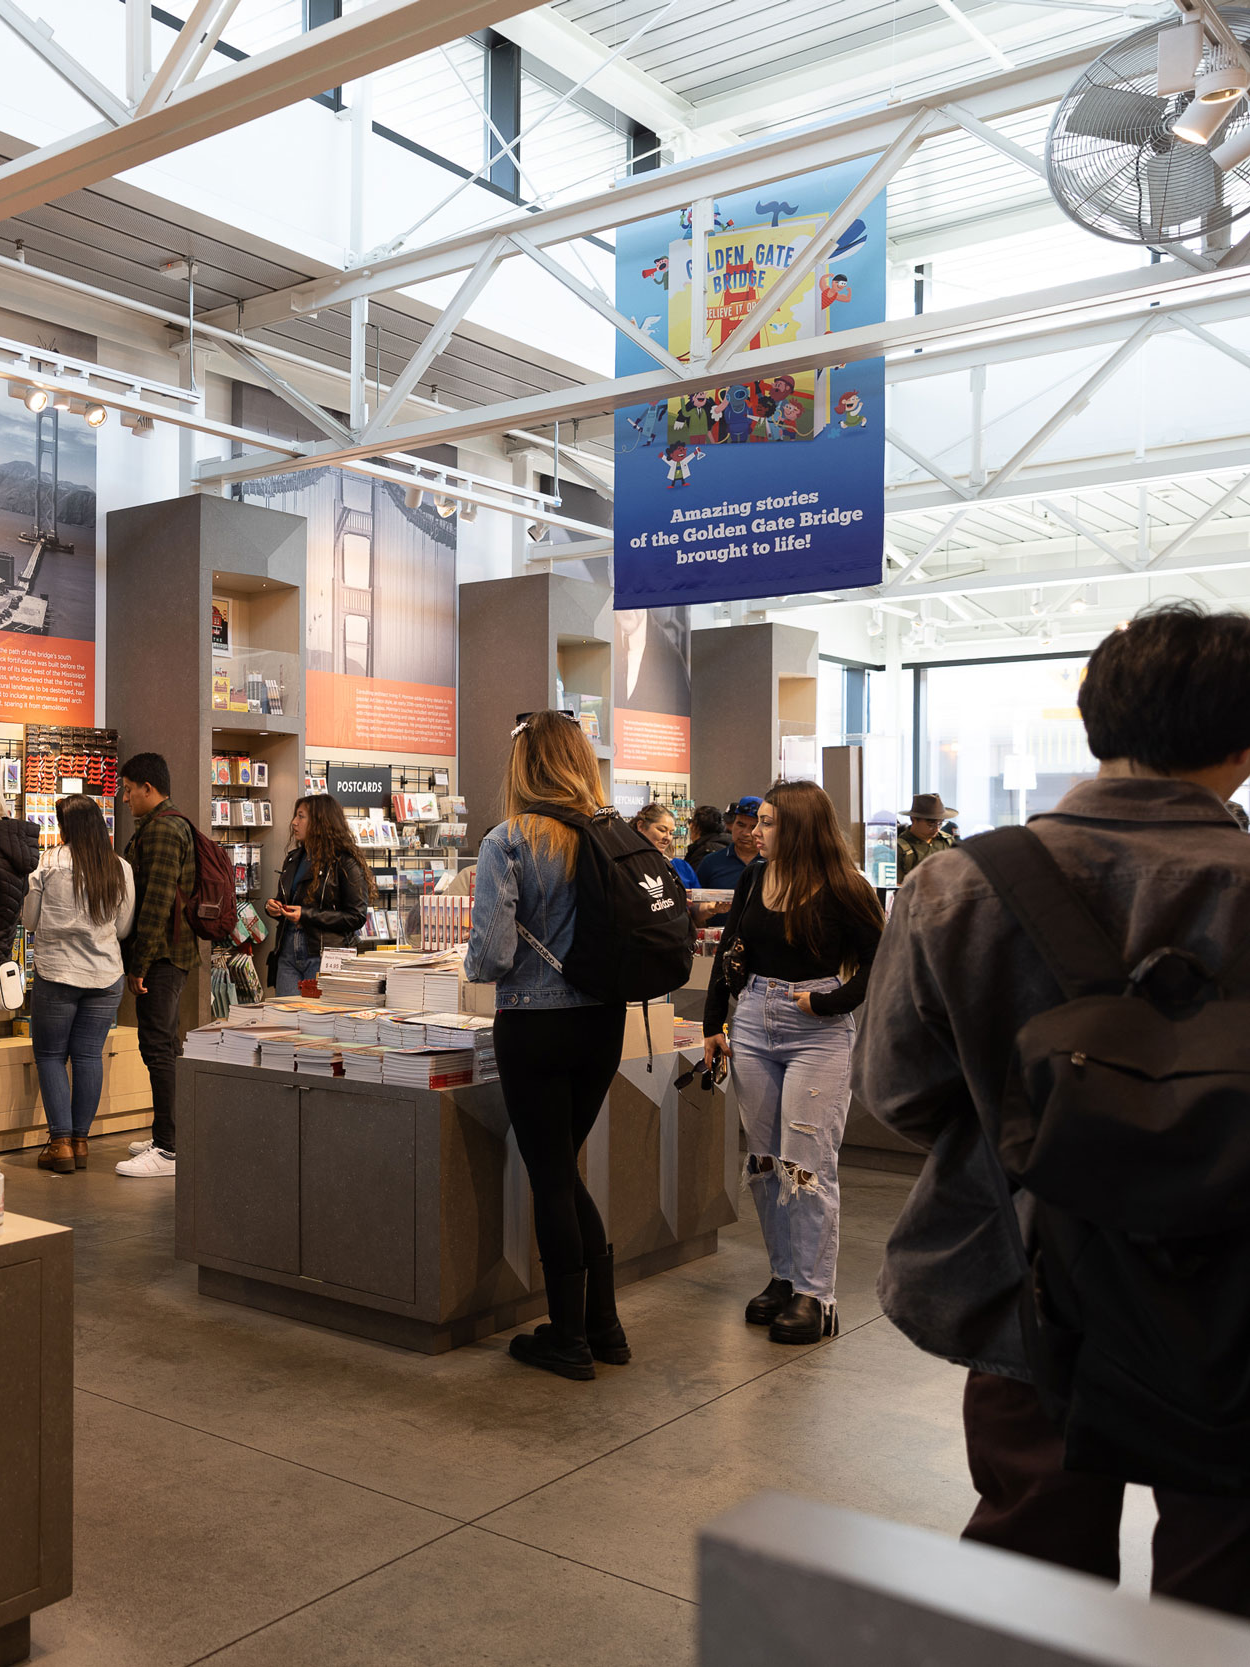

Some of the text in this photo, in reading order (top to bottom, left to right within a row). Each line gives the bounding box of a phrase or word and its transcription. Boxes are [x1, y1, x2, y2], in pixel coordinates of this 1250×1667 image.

[686, 244, 794, 279] GLDEN GATE
[713, 270, 766, 294] BRIDGE
[736, 303, 743, 315] IT
[670, 490, 819, 523] Amazing stories
[630, 507, 863, 548] of the Golden Gate Bridge
[676, 533, 812, 565] brought to life!
[337, 781, 382, 793] POSTCARDS
[615, 795, 644, 806] KEYCHAINS
[650, 898, 675, 912] adidas
